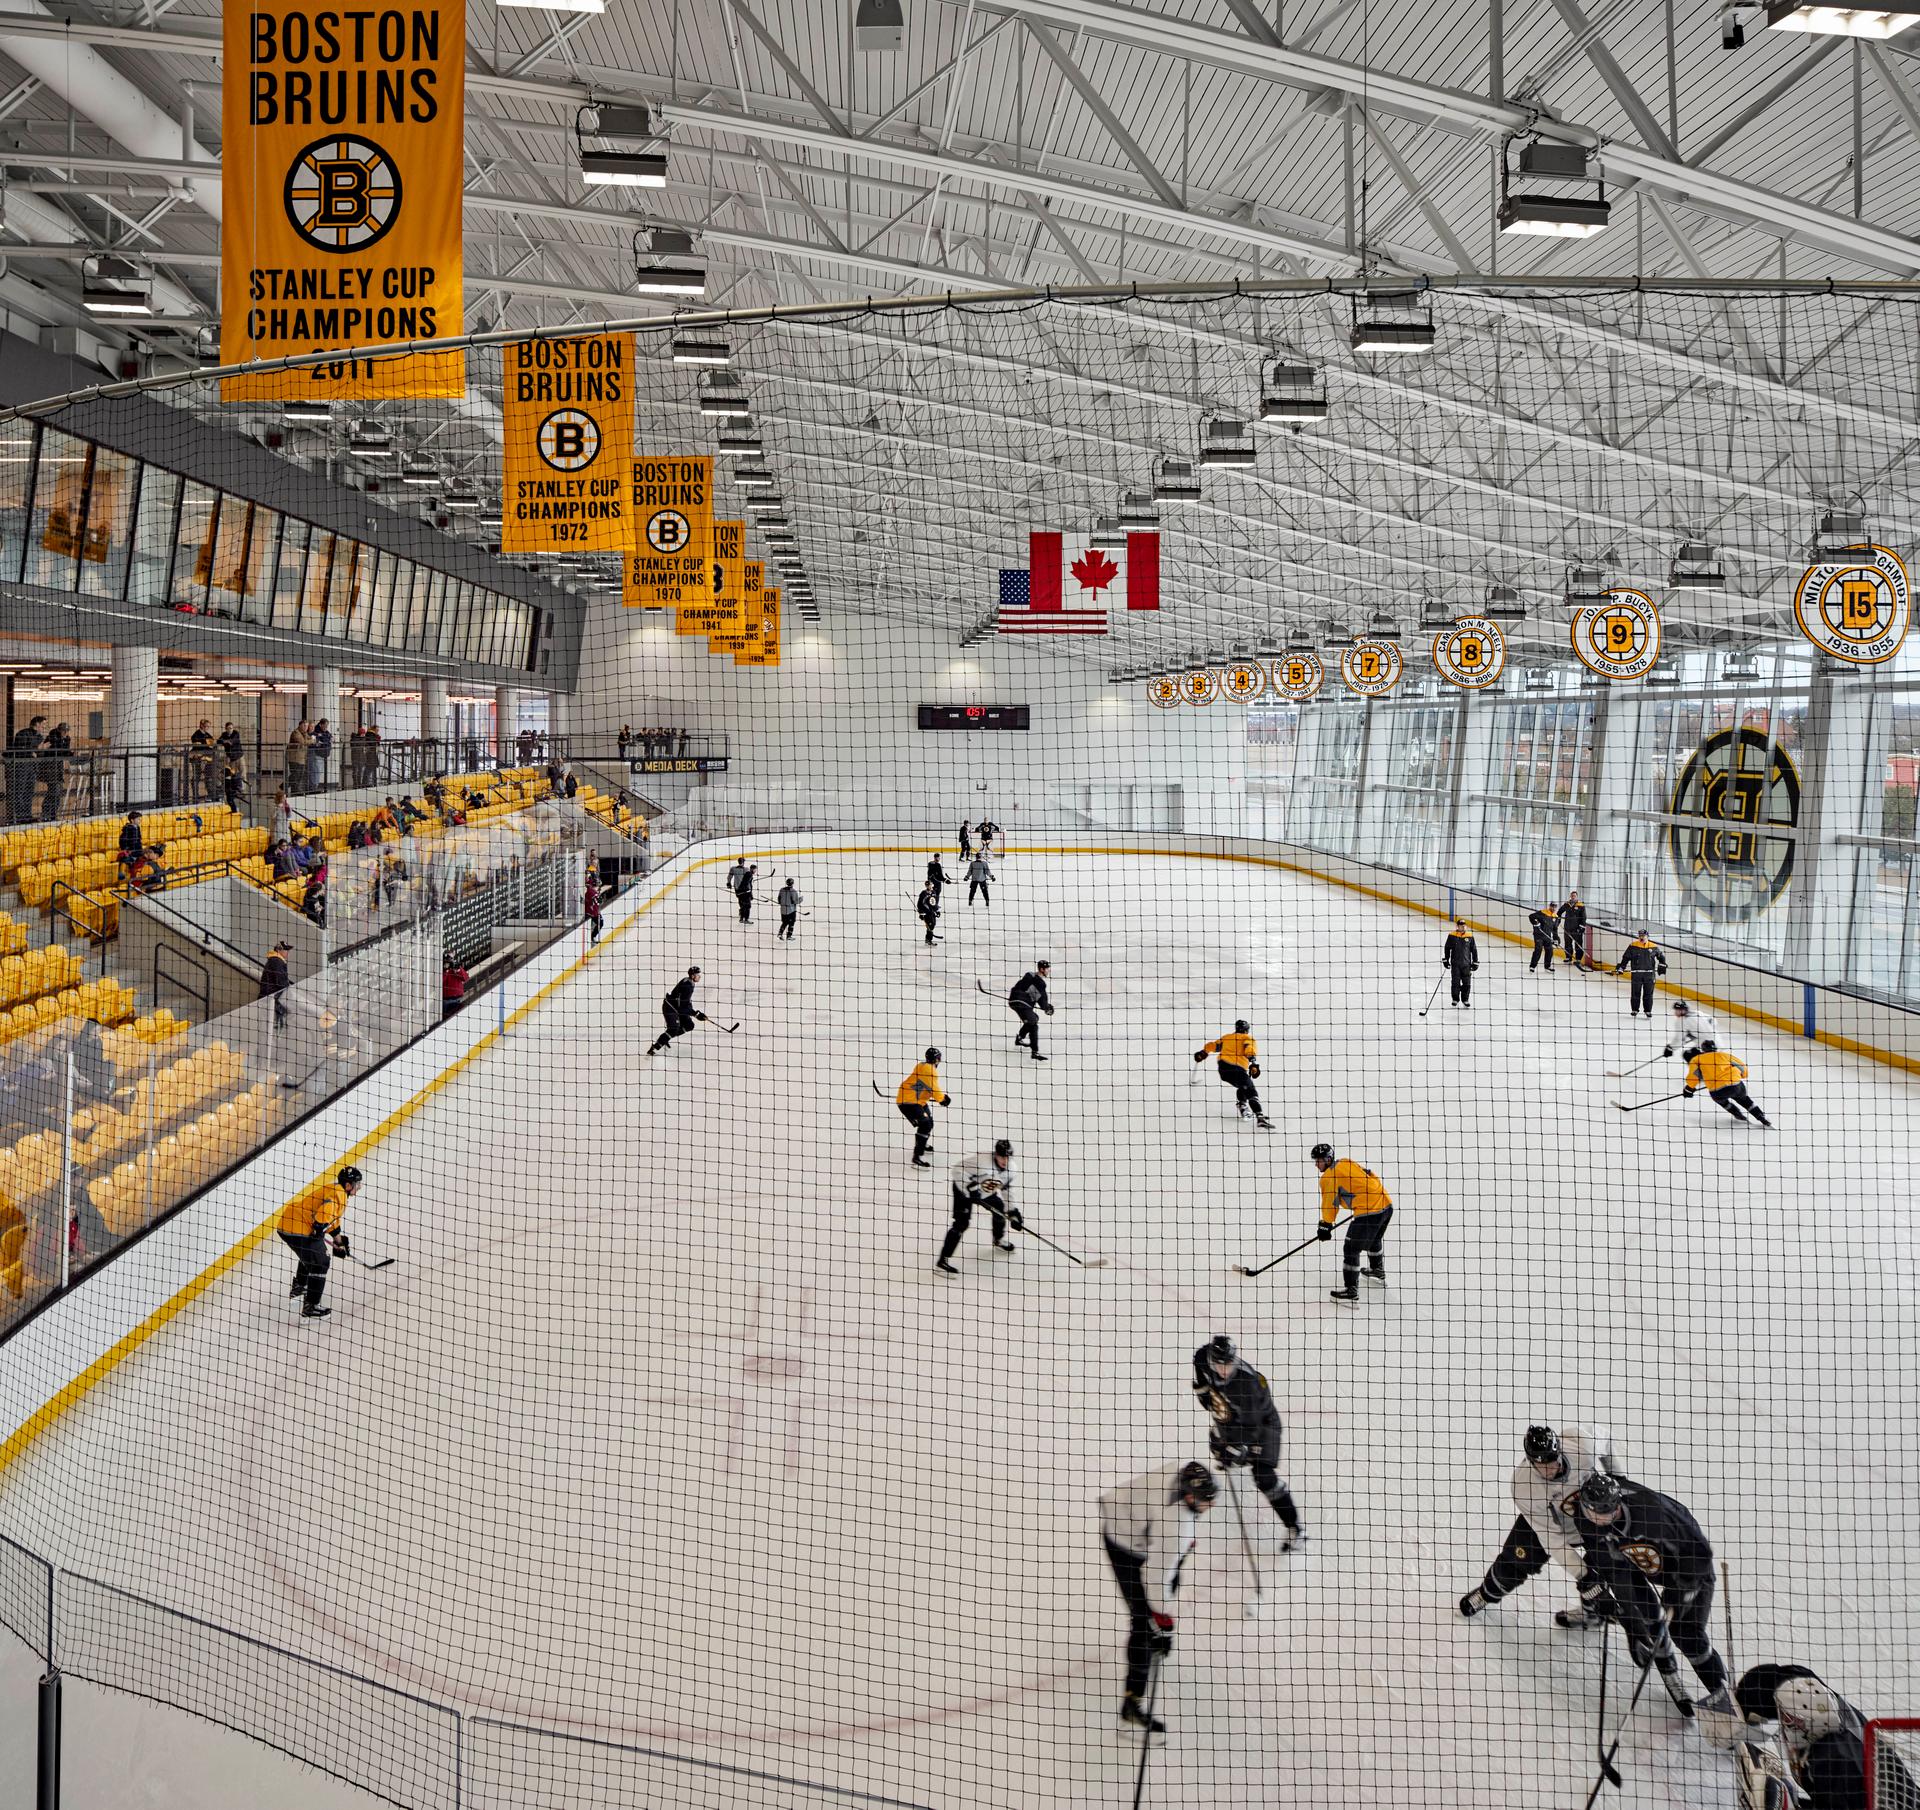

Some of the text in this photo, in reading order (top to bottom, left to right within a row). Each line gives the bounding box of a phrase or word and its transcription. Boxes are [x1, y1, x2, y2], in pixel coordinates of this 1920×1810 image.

[250, 10, 438, 64] BOSTON
[250, 68, 437, 125] BRUINS
[250, 267, 435, 301] STANLEY CUP
[247, 306, 437, 340] CHAMPIONS
[518, 340, 621, 368] BOSTON
[518, 371, 621, 402] BRUINS
[555, 422, 585, 457] B
[633, 462, 704, 482] BOSTON
[518, 479, 619, 498] STANLEY CUP
[633, 484, 704, 505] BRUINS
[517, 501, 621, 520] CHAMPIONS
[550, 523, 588, 541] 1972
[658, 519, 679, 544] B
[713, 526, 738, 542] TON
[714, 542, 738, 559] INS
[633, 558, 703, 570] STANLEY CUP
[632, 572, 704, 586] CHAMPIONS
[1805, 556, 1906, 606] MILTO CHMIDT
[655, 587, 682, 600] 1970
[722, 598, 737, 608] CUP
[1625, 594, 1654, 622] BUCYK
[1849, 591, 1871, 618] 15
[683, 609, 738, 619] CHAMPIONS
[701, 621, 721, 631] 1941
[1612, 624, 1627, 645] 9
[729, 641, 745, 650] 1939
[1438, 620, 1474, 653] CAMRON
[1487, 627, 1502, 653] NEELY
[1465, 644, 1477, 661] 8
[1365, 657, 1375, 671] 7
[1237, 674, 1246, 686] 4
[1292, 667, 1301, 680] 5
[1162, 685, 1170, 695] 2
[1195, 680, 1203, 691] 3
[644, 761, 673, 772] MEDIA
[675, 760, 698, 771] DECK
